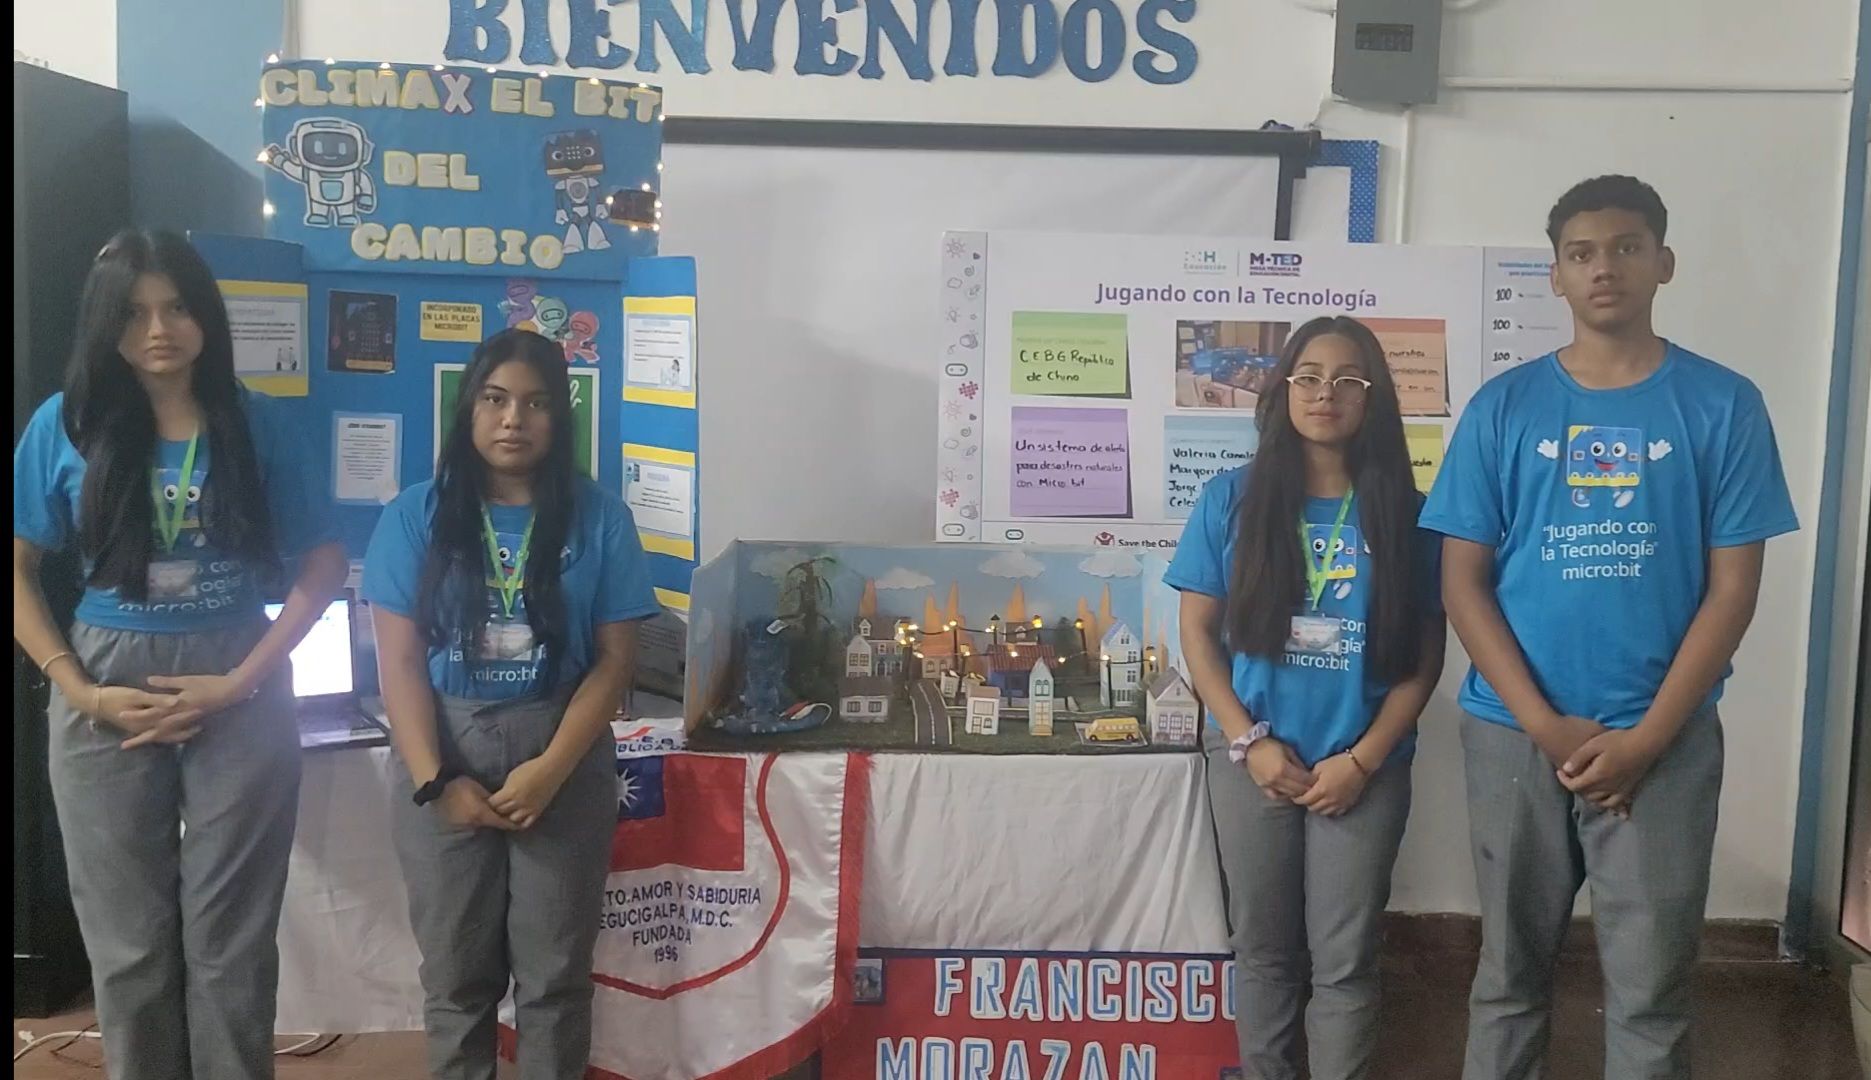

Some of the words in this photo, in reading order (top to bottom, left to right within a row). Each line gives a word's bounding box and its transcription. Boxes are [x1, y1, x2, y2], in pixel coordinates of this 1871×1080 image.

[444, 0, 1197, 84] BIENVENIDOS
[261, 68, 475, 115] CLIMAX
[490, 77, 555, 118] EL
[573, 79, 663, 123] BIT
[383, 151, 480, 191] DEL
[351, 223, 565, 270] CAMBIO
[1250, 252, 1303, 266] M-TED
[1095, 283, 1187, 306] Jugando
[1193, 287, 1230, 304] con
[1238, 286, 1256, 304] la
[1263, 287, 1377, 312] Tecnología
[1495, 288, 1512, 301] 100
[1493, 319, 1511, 330] 100
[1493, 352, 1511, 362] 100
[1026, 371, 1042, 381] de
[1090, 443, 1102, 452] de
[1016, 479, 1033, 488] con
[1168, 480, 1197, 496] Jorge
[1627, 521, 1657, 534] con
[1119, 539, 1139, 547] Save
[1159, 540, 1177, 548] Chil
[1541, 546, 1555, 561] la
[1562, 562, 1642, 581] micro:bit
[450, 648, 463, 662] la
[676, 882, 684, 899] Y
[688, 884, 761, 906] SABIDURIA
[600, 903, 689, 930] EGUCIGALPA,
[633, 925, 692, 946] FUNDADA
[655, 945, 679, 963] 1996
[876, 1036, 1156, 1080] MORAZAN
